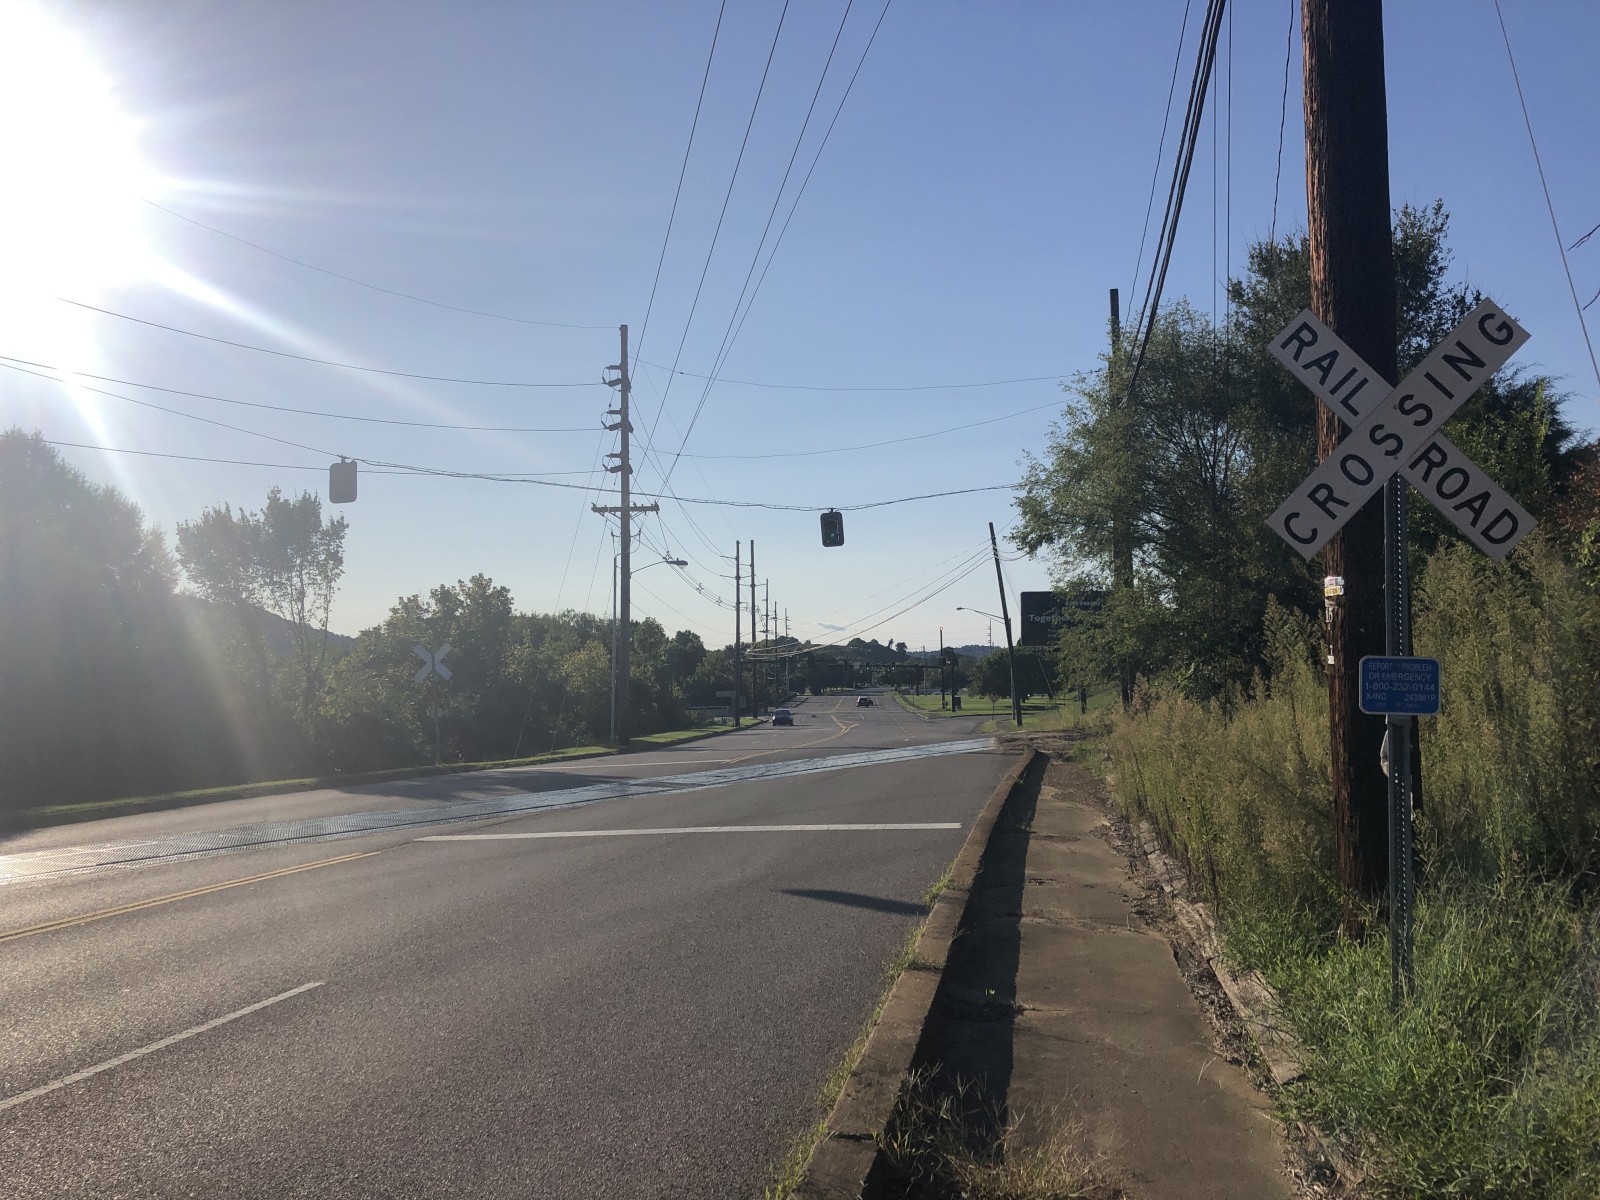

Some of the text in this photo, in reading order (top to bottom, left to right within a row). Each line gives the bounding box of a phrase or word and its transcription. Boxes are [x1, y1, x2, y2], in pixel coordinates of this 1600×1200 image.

[1279, 321, 1519, 545] RAIL ROAD
[1283, 312, 1514, 545] CROSSING
[1368, 662, 1432, 671] REPORT PROBLEM
[1368, 672, 1432, 681] OR EMERGENCY
[1366, 682, 1435, 692] 1-800-232-0144
